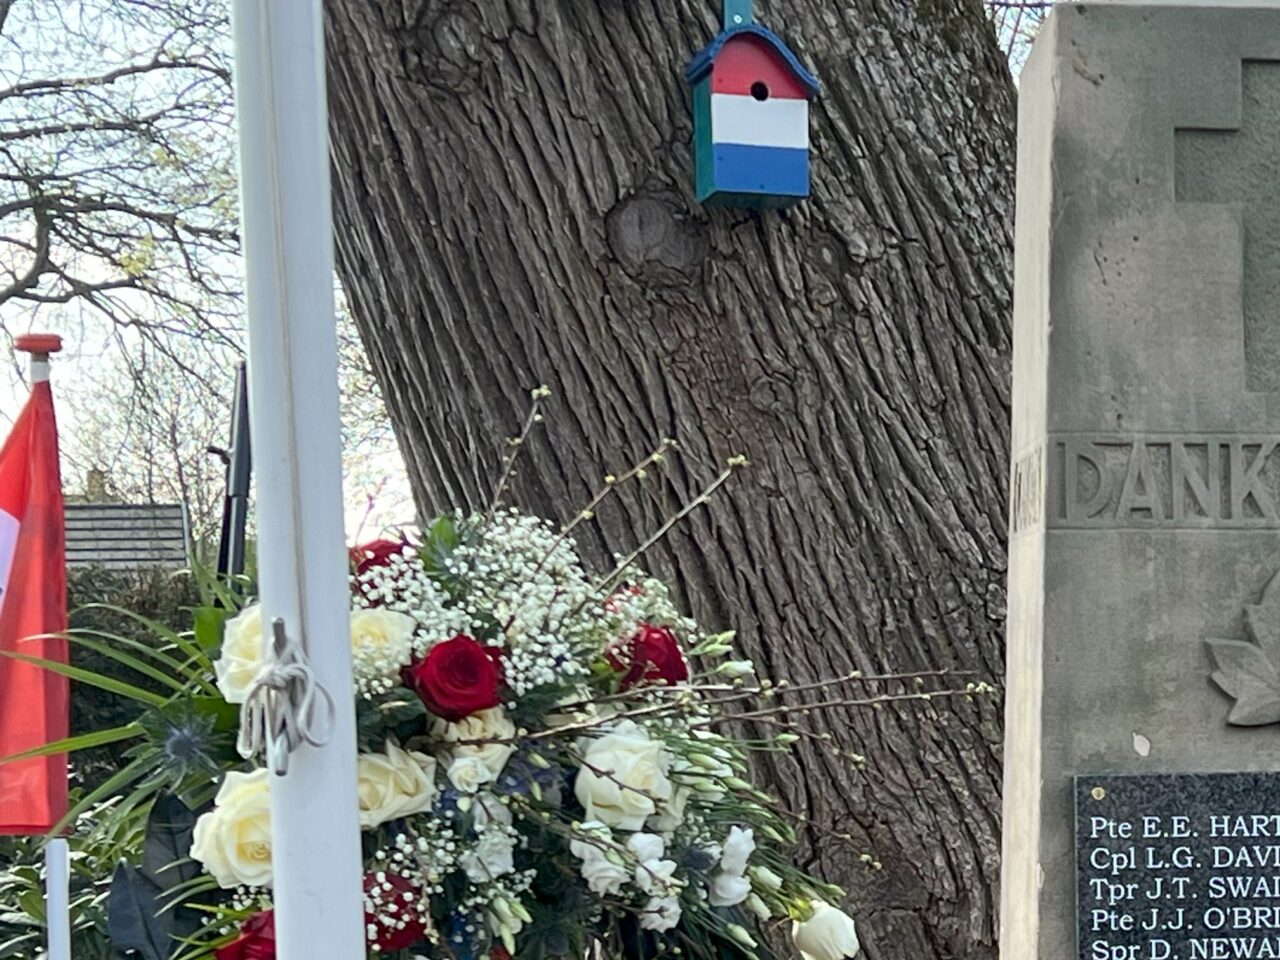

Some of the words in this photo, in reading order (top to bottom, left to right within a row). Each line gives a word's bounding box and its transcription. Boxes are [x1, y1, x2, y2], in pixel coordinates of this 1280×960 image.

[1090, 816, 1132, 839] Pte
[1141, 815, 1199, 838] E.E.
[1090, 846, 1137, 875] Cpl
[1146, 846, 1202, 869] L.G.
[1089, 878, 1139, 906] Tpr
[1145, 877, 1198, 900] J.T.
[1091, 909, 1134, 931] Pte
[1141, 908, 1193, 931] J.J.
[1149, 939, 1178, 960] D.
